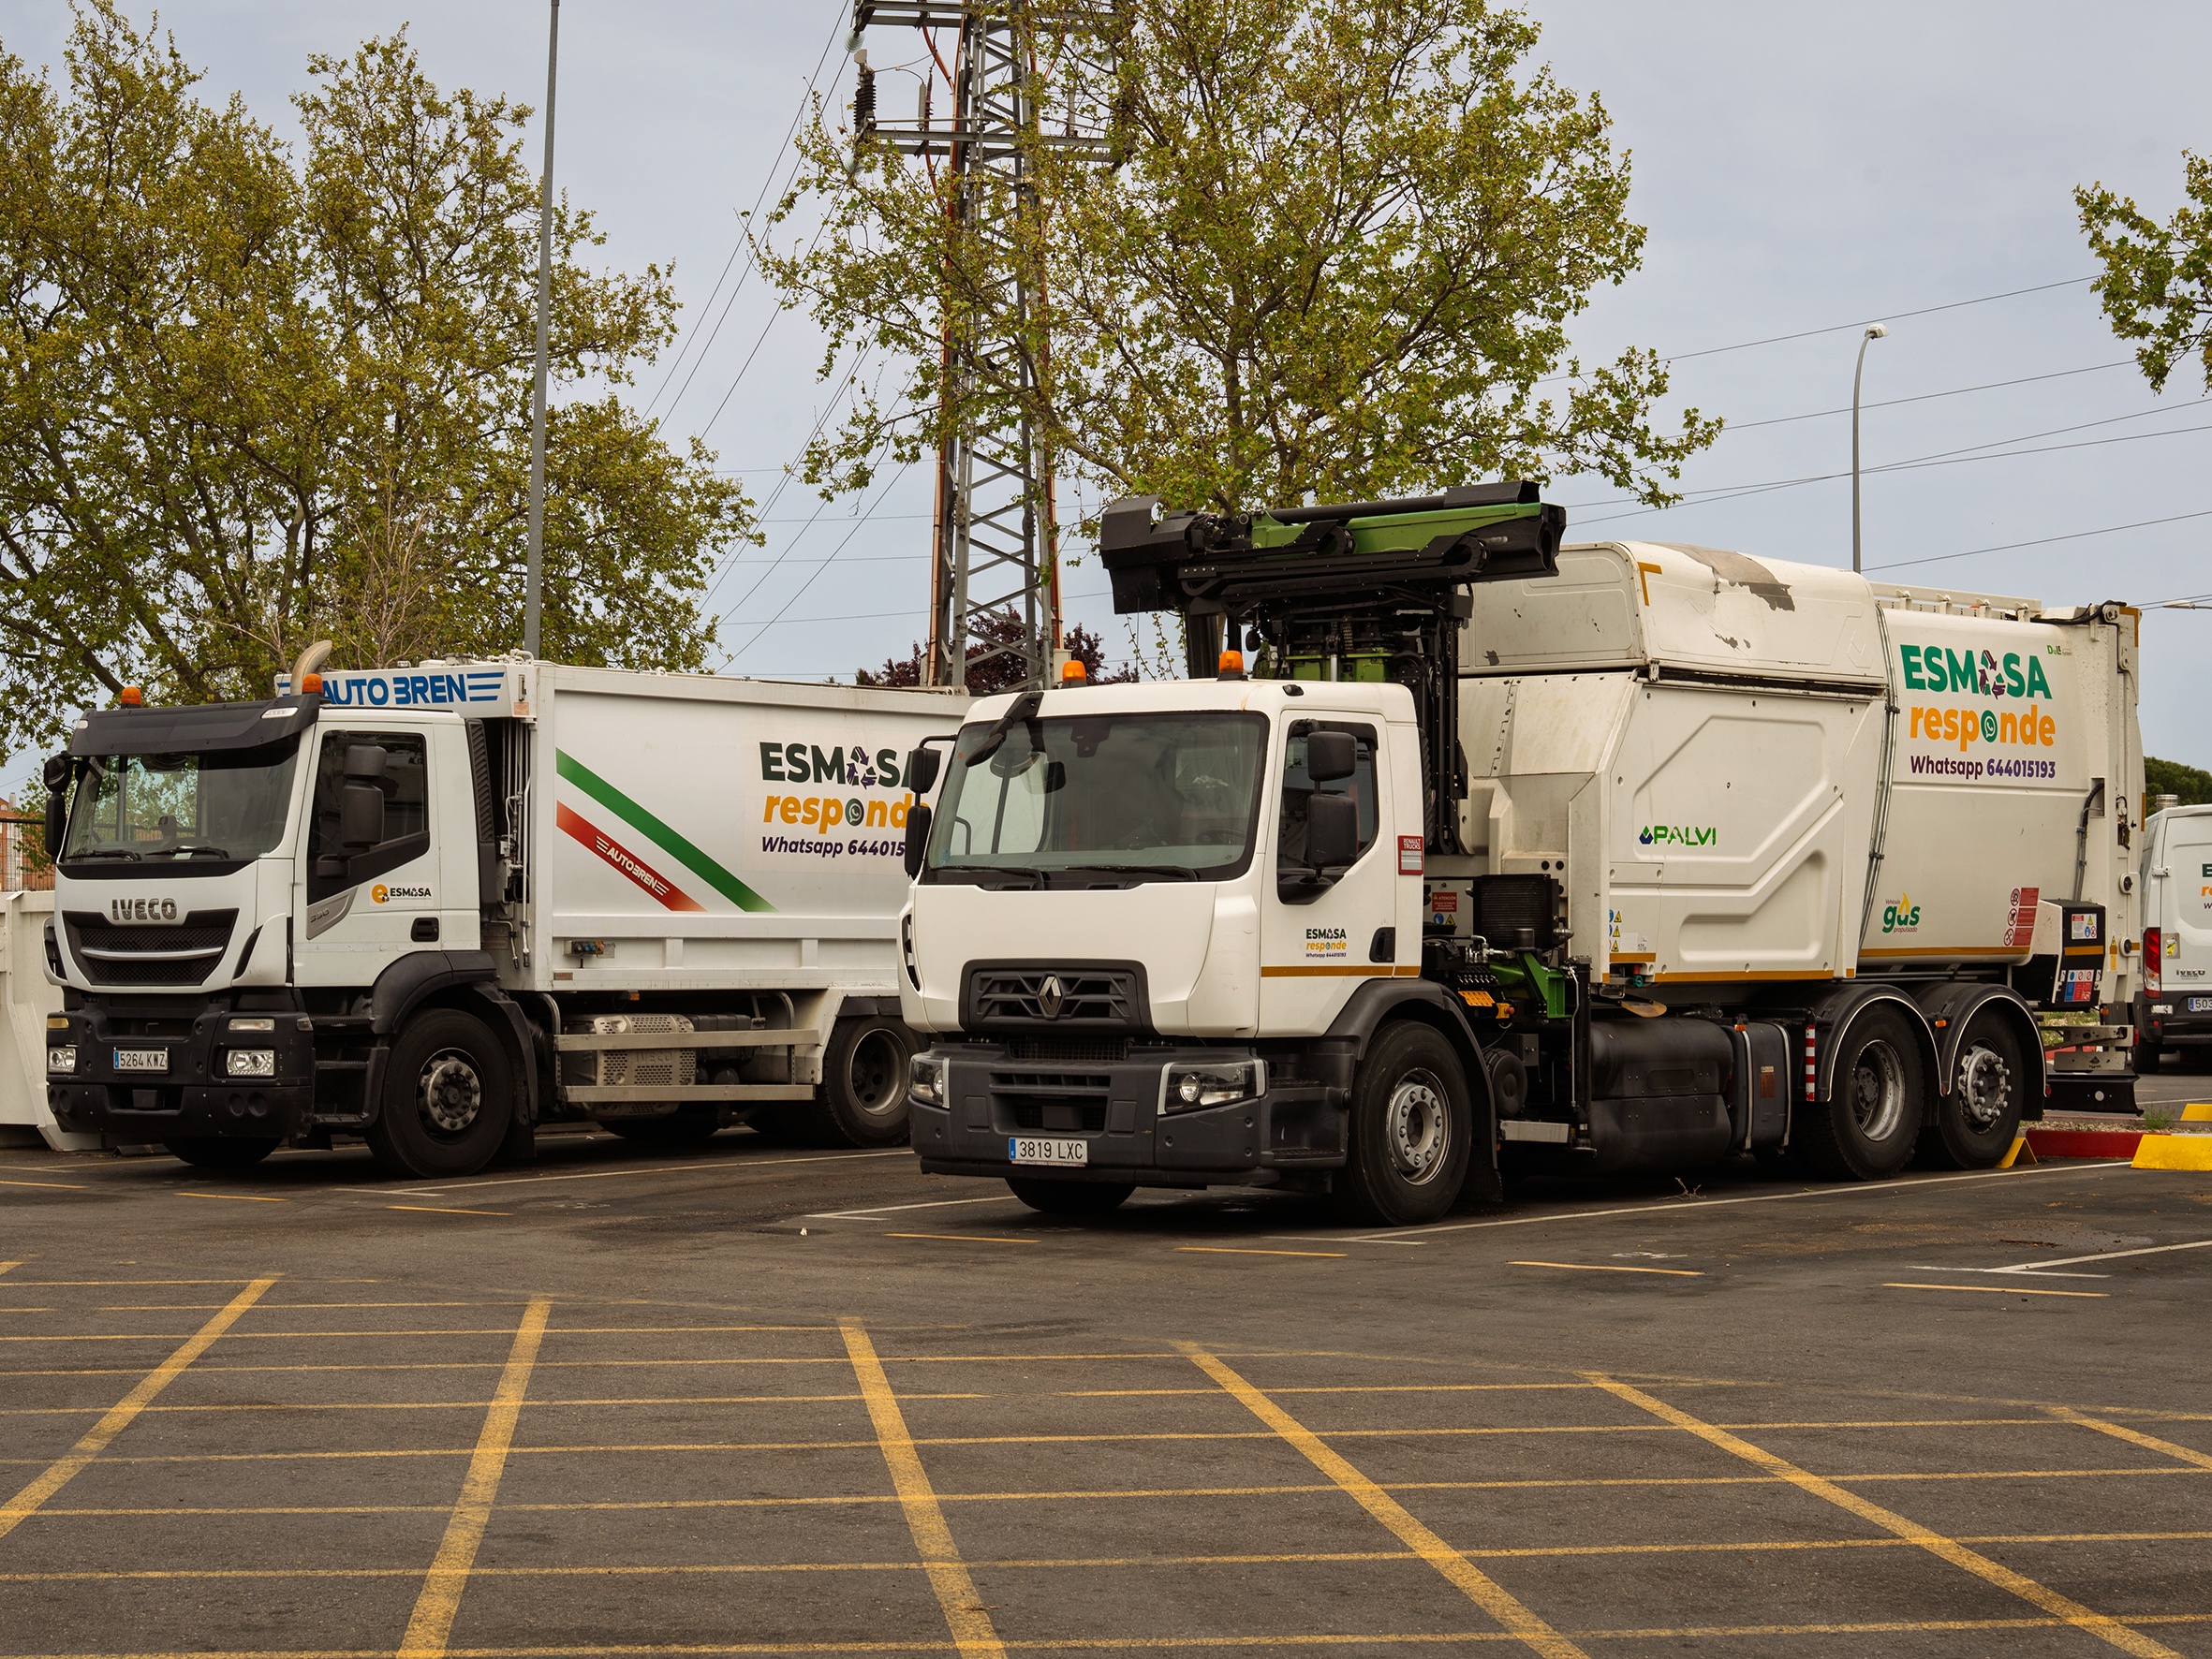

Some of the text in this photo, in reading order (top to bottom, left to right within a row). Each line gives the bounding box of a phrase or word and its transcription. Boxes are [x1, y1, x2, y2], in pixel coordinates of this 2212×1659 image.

[1900, 644, 2053, 699] ESMASA
[322, 673, 467, 705] AUTO BREN
[1910, 704, 2056, 752] responde
[759, 741, 913, 789] ESMAS
[1910, 755, 2056, 780] Whatsapp 644015193
[763, 793, 930, 834] respond
[1654, 825, 1717, 846] PALVI
[761, 836, 907, 858] Whatsapp 644015
[390, 888, 432, 897] ESMASA
[111, 898, 177, 920] IVECO
[1305, 928, 1347, 939] ESMASA
[1305, 940, 1347, 952] responde
[2195, 999, 2212, 1008] 503
[120, 1053, 166, 1067] 5264 KWZ
[1019, 1141, 1052, 1158] 3819
[1057, 1142, 1083, 1159] LXC
